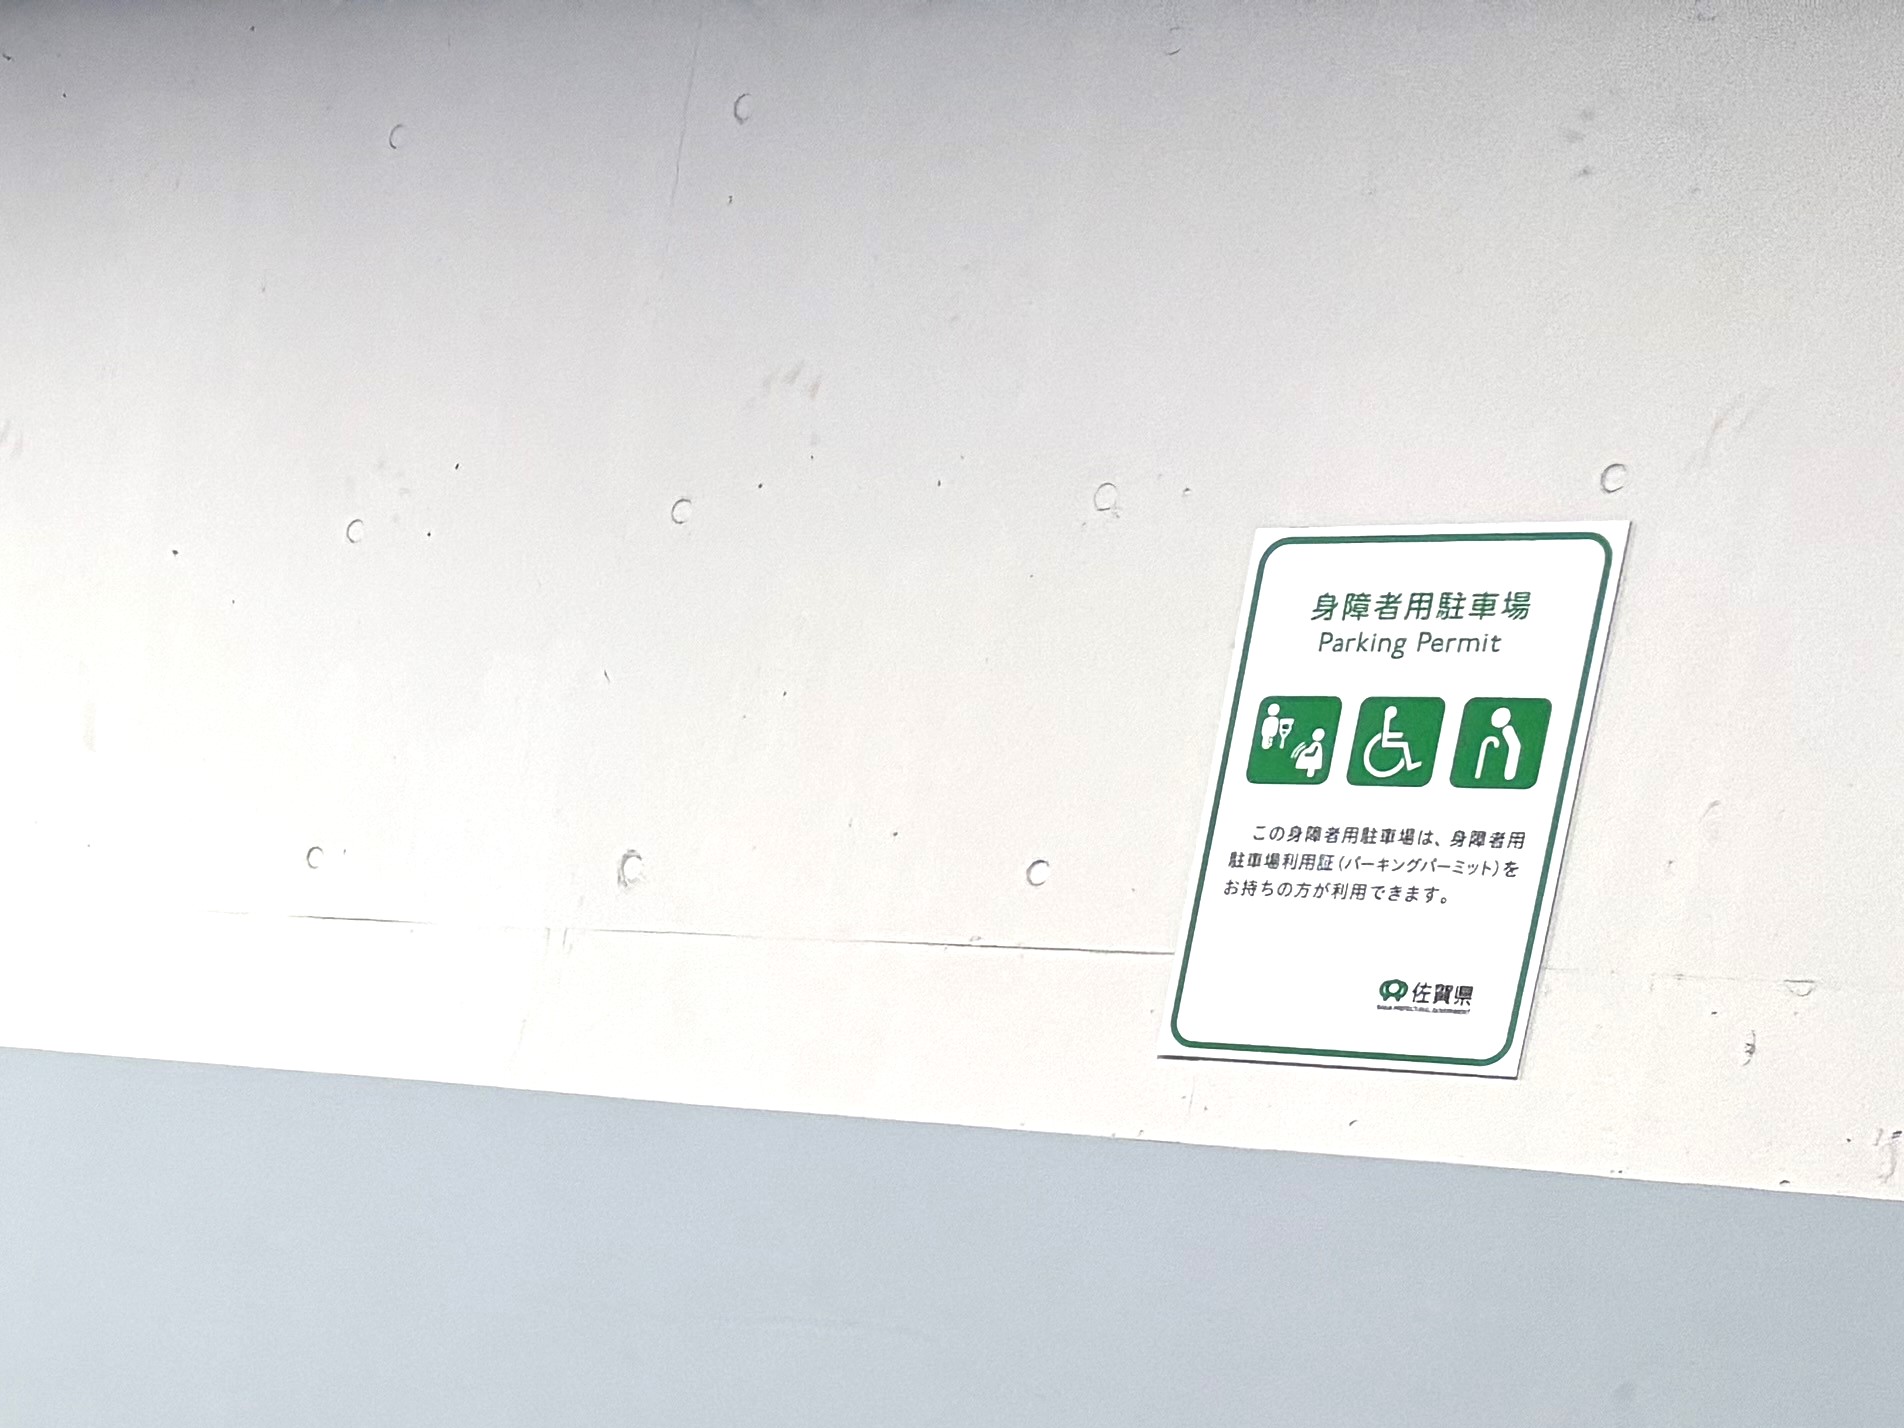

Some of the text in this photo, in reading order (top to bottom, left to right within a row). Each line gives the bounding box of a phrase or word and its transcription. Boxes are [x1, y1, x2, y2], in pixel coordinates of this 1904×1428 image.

[1310, 591, 1532, 622] 身障者用駐車場
[1318, 631, 1503, 660] Parking Permit
[1223, 879, 1447, 905] お持ちの方が利用できます。
[1411, 981, 1474, 1007] 佐賀県
